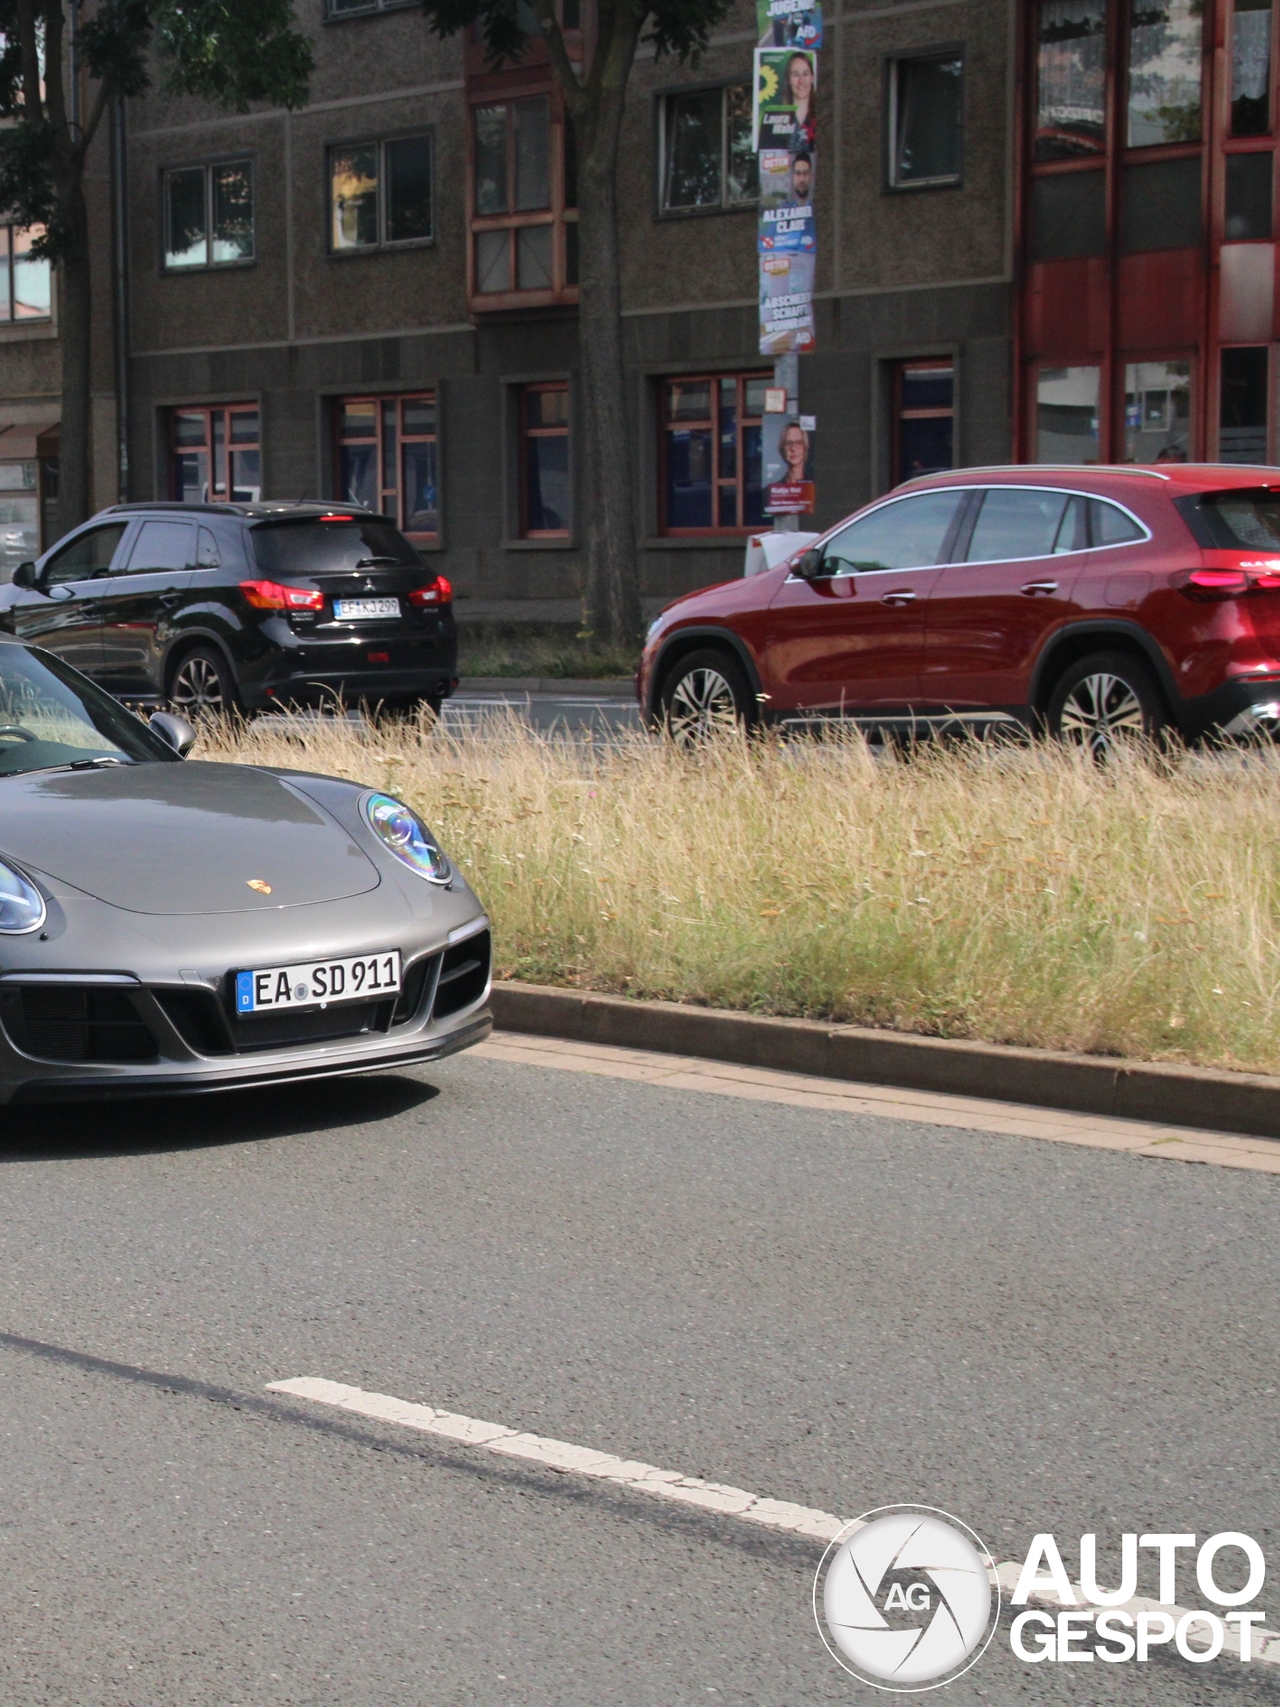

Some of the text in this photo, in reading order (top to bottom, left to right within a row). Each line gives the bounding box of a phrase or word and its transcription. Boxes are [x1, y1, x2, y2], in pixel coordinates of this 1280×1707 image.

[341, 599, 398, 613] EF KJ 299
[242, 957, 397, 1005] D EA SD 911
